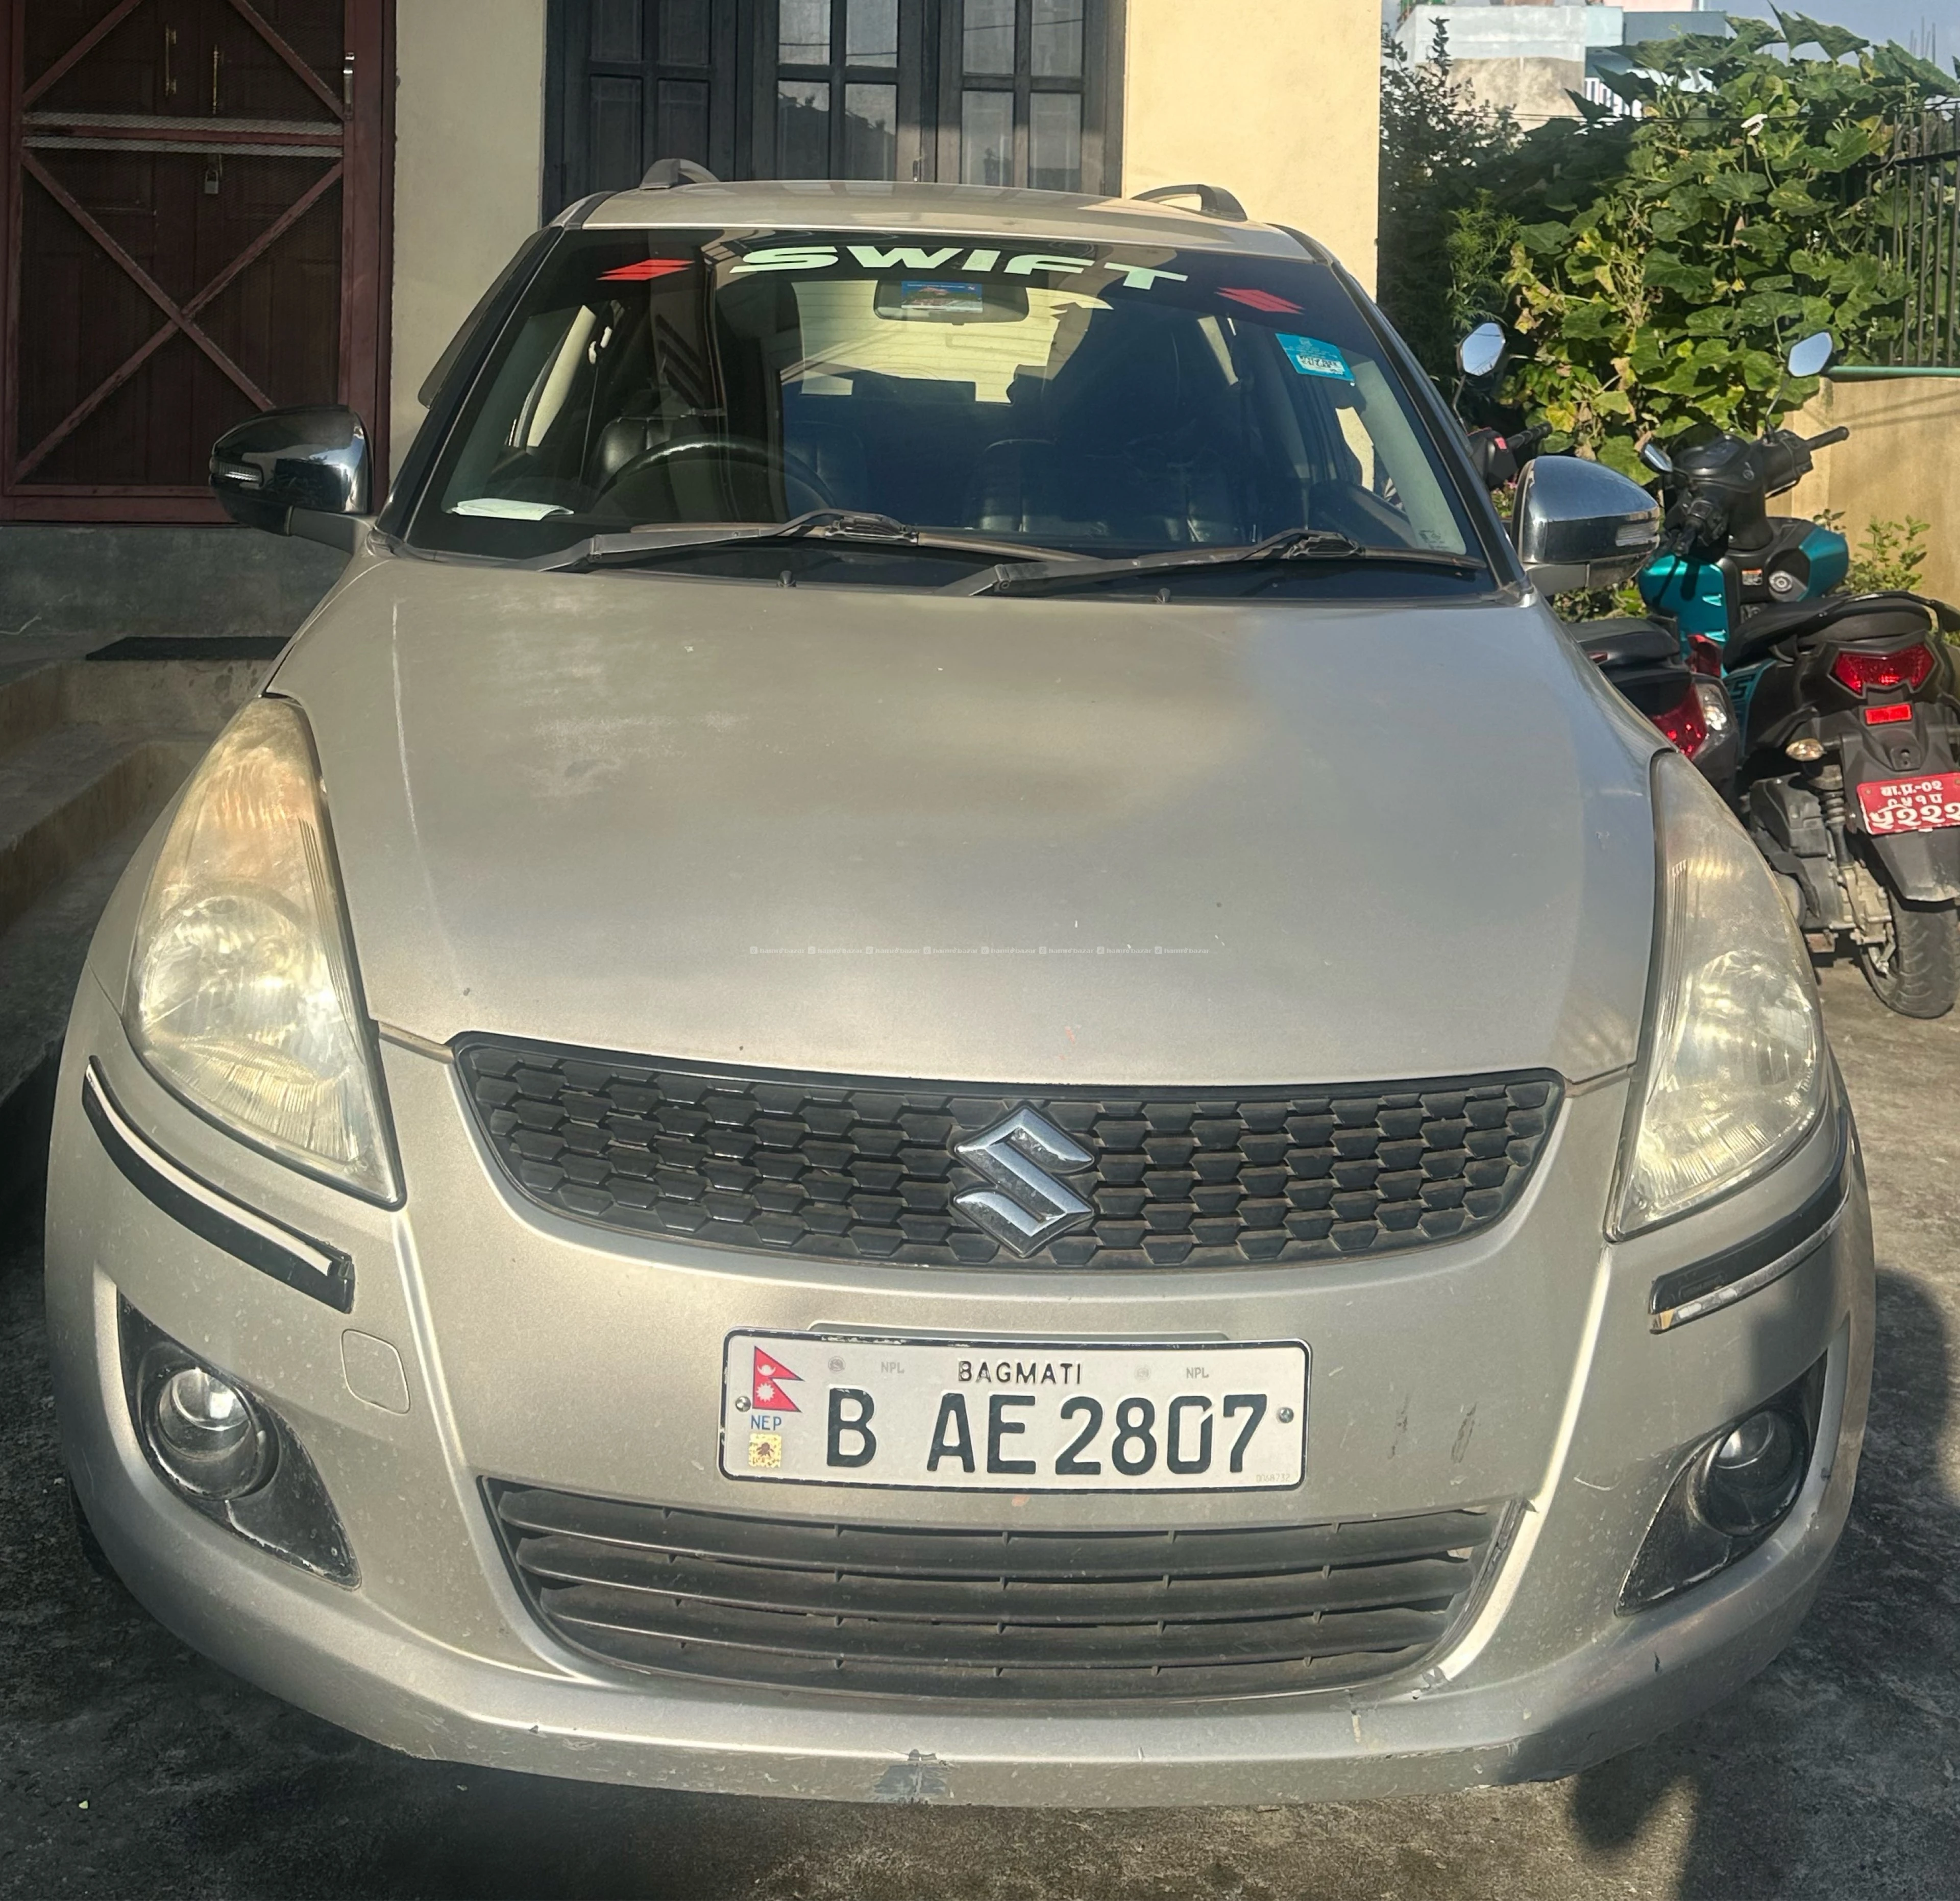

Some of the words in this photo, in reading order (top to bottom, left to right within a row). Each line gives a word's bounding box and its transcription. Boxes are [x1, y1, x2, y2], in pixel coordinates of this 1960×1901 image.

[730, 246, 1188, 289] SWIFT
[880, 1361, 905, 1374] NPL
[958, 1360, 1081, 1384] BAGMATI
[1186, 1367, 1210, 1379] NPL
[751, 1415, 782, 1431] NEP
[826, 1387, 877, 1468] B
